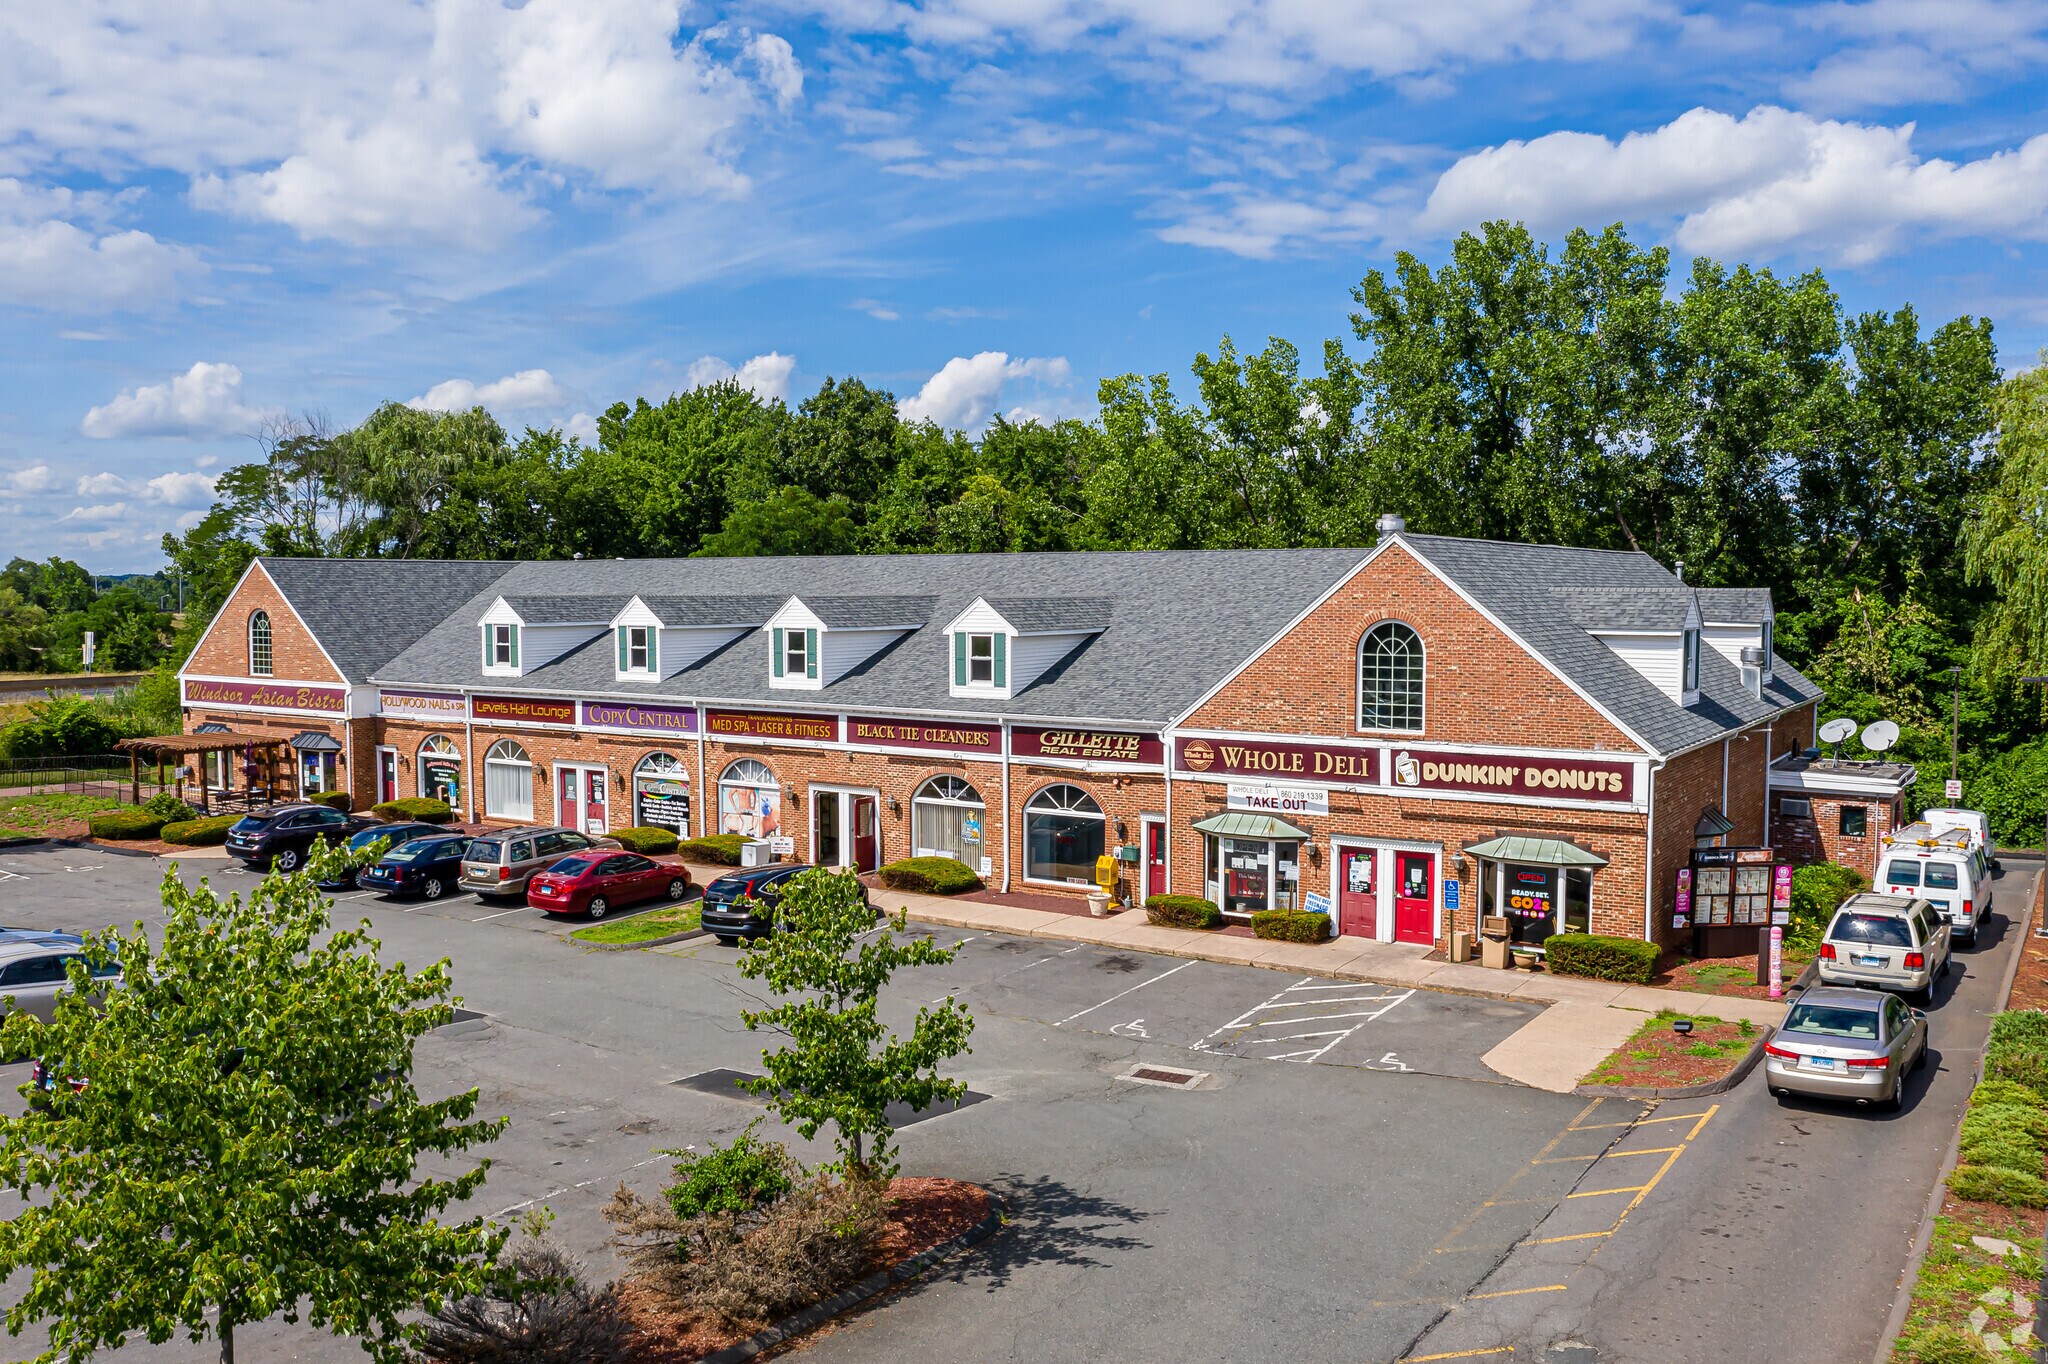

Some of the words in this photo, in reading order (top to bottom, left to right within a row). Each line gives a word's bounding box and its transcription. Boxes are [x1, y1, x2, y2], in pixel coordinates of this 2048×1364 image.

[186, 681, 243, 702] Windsor
[249, 686, 294, 706] Asian
[297, 687, 344, 709] Bistro
[381, 696, 426, 708] HOLLYWOOD
[429, 698, 450, 710] NAILS
[456, 702, 466, 711] SPA
[476, 701, 508, 713] Levels
[510, 703, 529, 715] Hair
[530, 706, 571, 719] Lounge
[748, 714, 793, 722] TRANSFORMATIONS
[712, 719, 732, 731] MED
[734, 721, 750, 732] SPA
[756, 722, 784, 735] LASER
[785, 723, 793, 735] &
[794, 724, 831, 738] FITNESS
[857, 724, 896, 739] BLACK
[899, 727, 920, 741] TIE
[924, 729, 990, 746] CLEANERS
[1040, 730, 1140, 751] GILLETTE
[1040, 746, 1077, 755] REAL
[1082, 749, 1139, 759] ESTATE
[1219, 746, 1305, 772] WHOLE
[1313, 752, 1369, 777] DELI
[1422, 762, 1519, 786] DUNKIN'
[1524, 767, 1623, 793] DONUTS
[941, 788, 967, 798] CLANING
[1232, 786, 1253, 794] WHOLE
[1254, 787, 1269, 795] DELI
[1281, 790, 1292, 798] 860
[1293, 791, 1305, 799] 219
[1306, 792, 1323, 800] 1339
[1246, 796, 1279, 809] TAKE
[1283, 799, 1308, 811] OUT
[1517, 873, 1544, 882] OPEN
